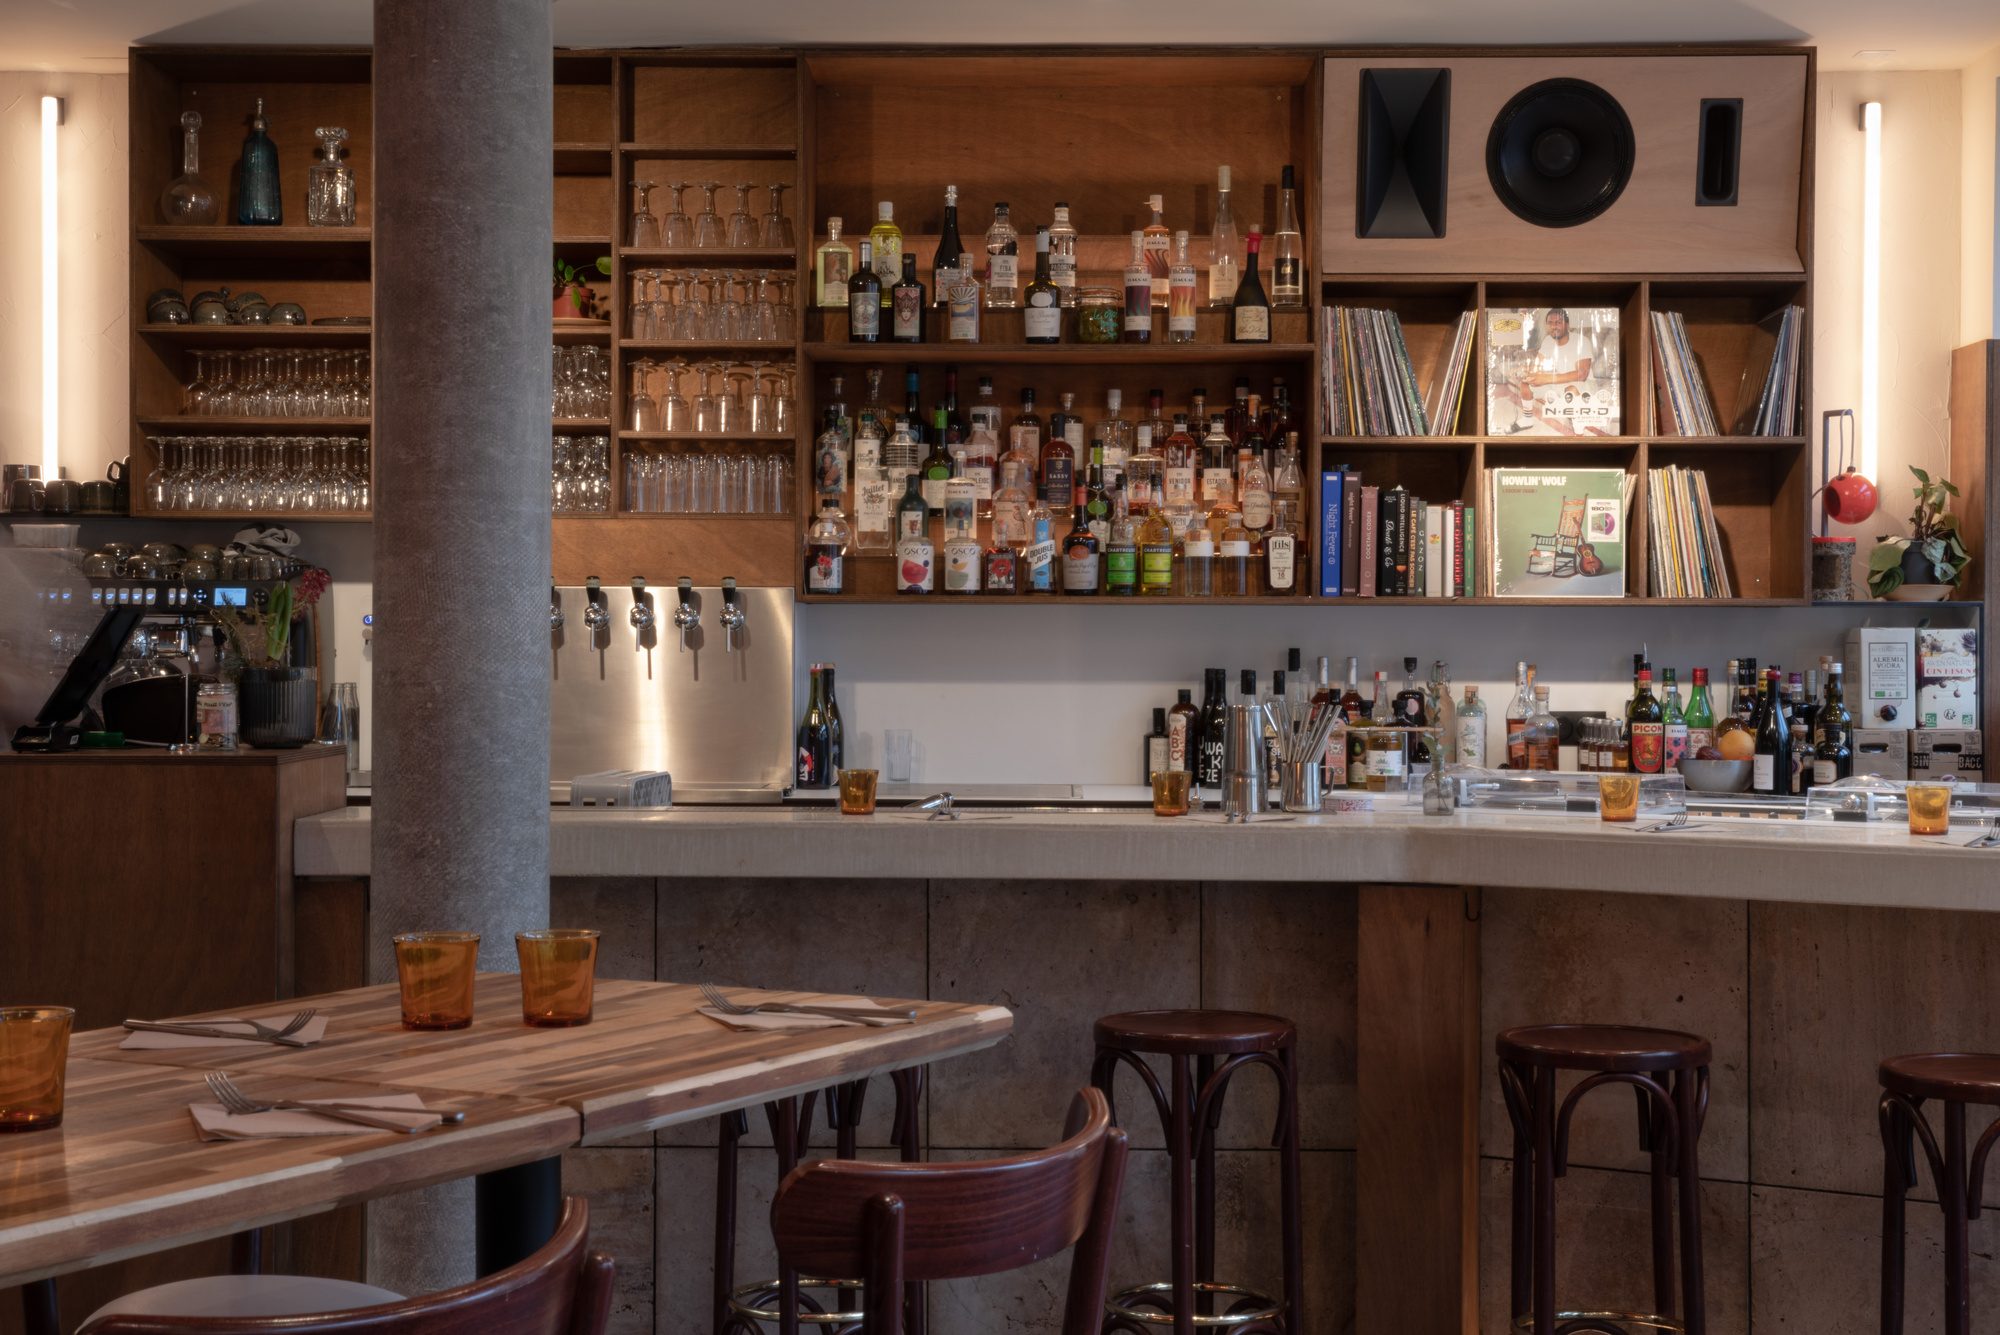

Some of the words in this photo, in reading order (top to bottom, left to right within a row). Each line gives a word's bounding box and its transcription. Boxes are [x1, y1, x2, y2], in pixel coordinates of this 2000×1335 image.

[1502, 476, 1540, 486] HOWLIN'
[1541, 476, 1567, 486] WOLF
[862, 484, 885, 496] Juillet
[1326, 503, 1337, 528] Night
[1411, 510, 1417, 518] LE
[1384, 520, 1395, 545] Death
[1274, 540, 1290, 549] fils
[1328, 531, 1337, 556] Fever
[904, 547, 929, 556] OSCO
[951, 547, 976, 556] OSCO
[1029, 544, 1054, 559] DOUBLE
[1034, 553, 1048, 564] JUS
[1206, 769, 1218, 783] ZE
